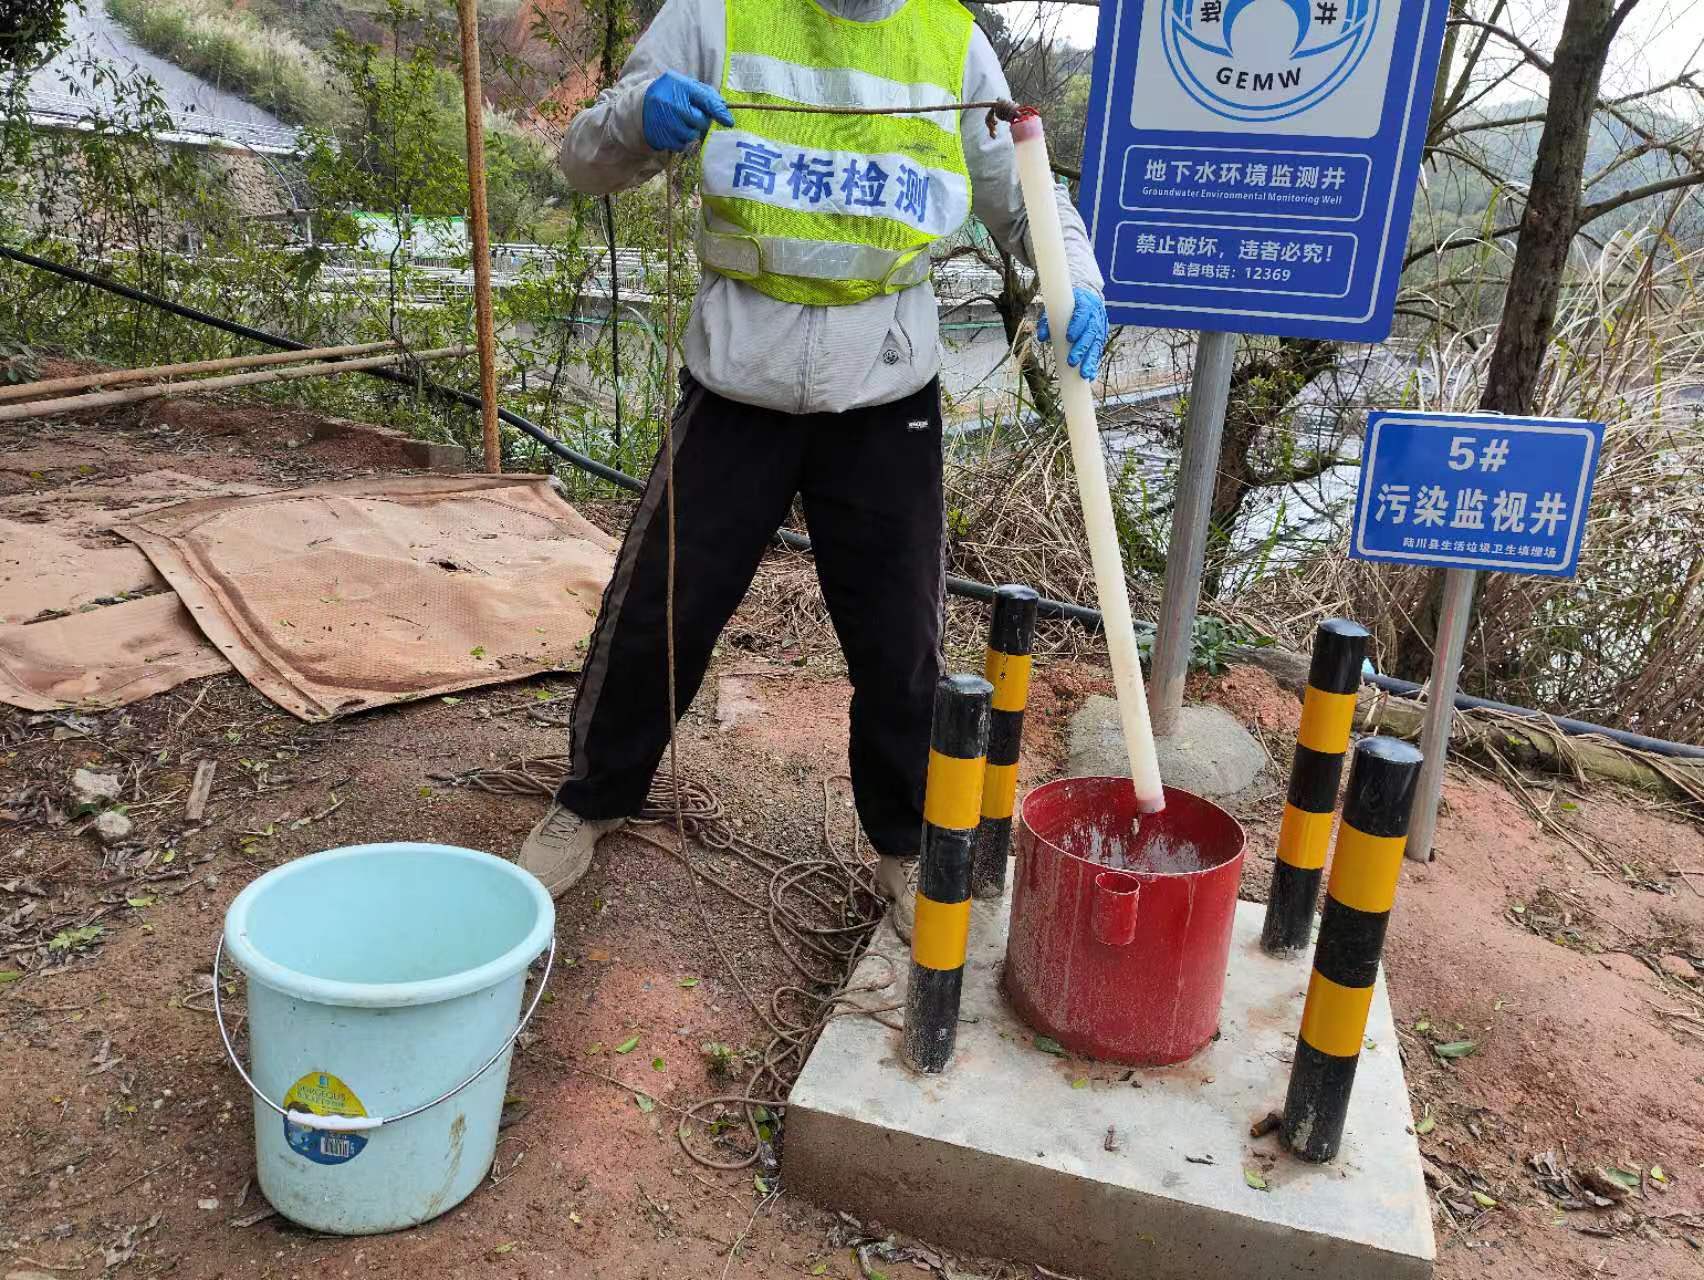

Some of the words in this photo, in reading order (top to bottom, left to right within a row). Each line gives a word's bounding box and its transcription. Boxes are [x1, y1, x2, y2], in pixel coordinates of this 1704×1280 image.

[1314, 1, 1338, 25] 井
[1216, 66, 1301, 91] GEMW
[732, 141, 930, 223] 高标检测
[1144, 159, 1346, 191] 地下水环境监测井
[1142, 186, 1199, 199] Groundwater
[1201, 189, 1266, 201] Environmental
[1268, 191, 1320, 206] Monitoring
[1322, 195, 1343, 205] Well
[1448, 436, 1510, 472] 5#
[1375, 483, 1567, 537] 污染监视井
[1402, 537, 1557, 559] 陆川县生活垃圾卫生填埋场
